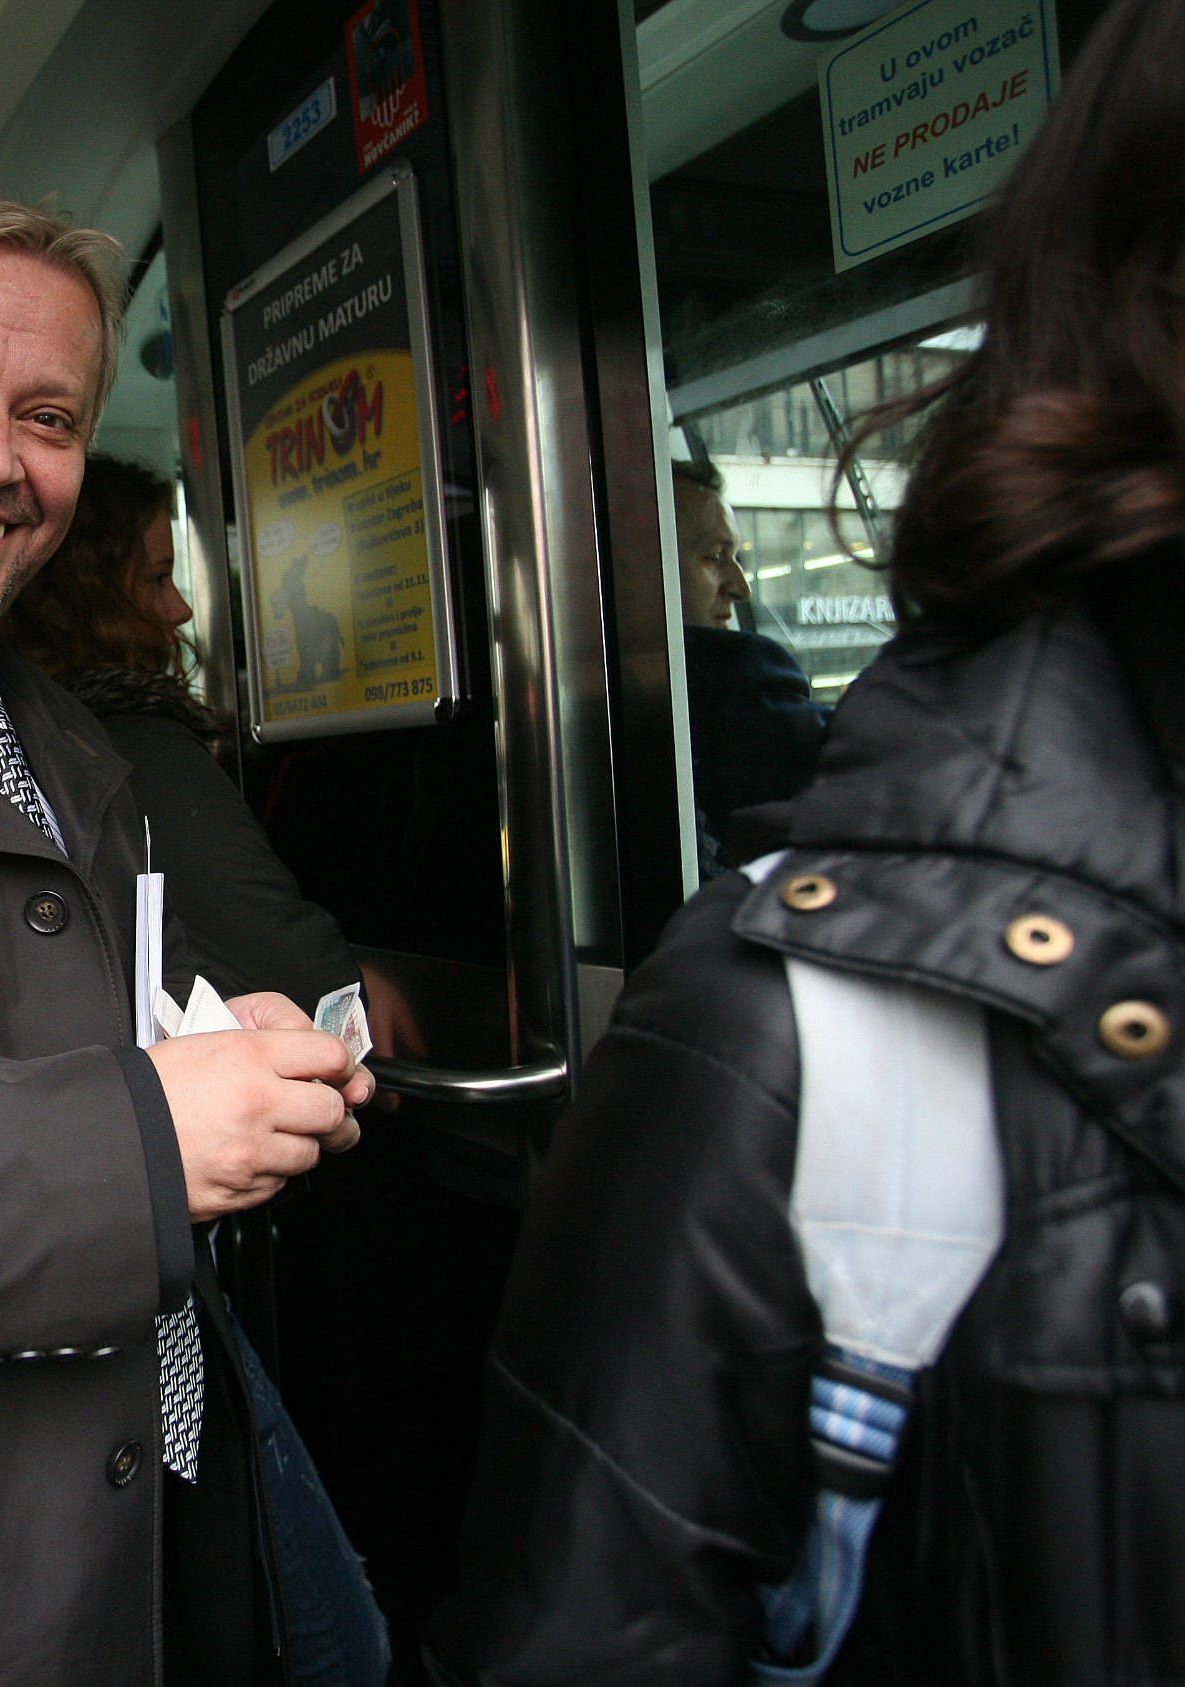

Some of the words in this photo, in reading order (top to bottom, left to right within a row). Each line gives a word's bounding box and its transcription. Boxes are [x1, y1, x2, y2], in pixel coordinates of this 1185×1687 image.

[839, 67, 943, 136] tramvaju
[952, 14, 1034, 73] vozač
[880, 57, 896, 82] U
[906, 17, 977, 68] ovom
[283, 99, 321, 150] 2253
[853, 143, 886, 178] NE
[894, 70, 1028, 158] PRODAJE
[863, 170, 935, 214] vozne
[943, 123, 1019, 178] karte!
[247, 324, 315, 385] DRŽAVNU
[318, 274, 392, 342] MATURU
[263, 258, 338, 330] PRIPREME
[341, 242, 364, 275] ZA
[266, 369, 384, 487] TRINOM
[412, 677, 433, 694] 875
